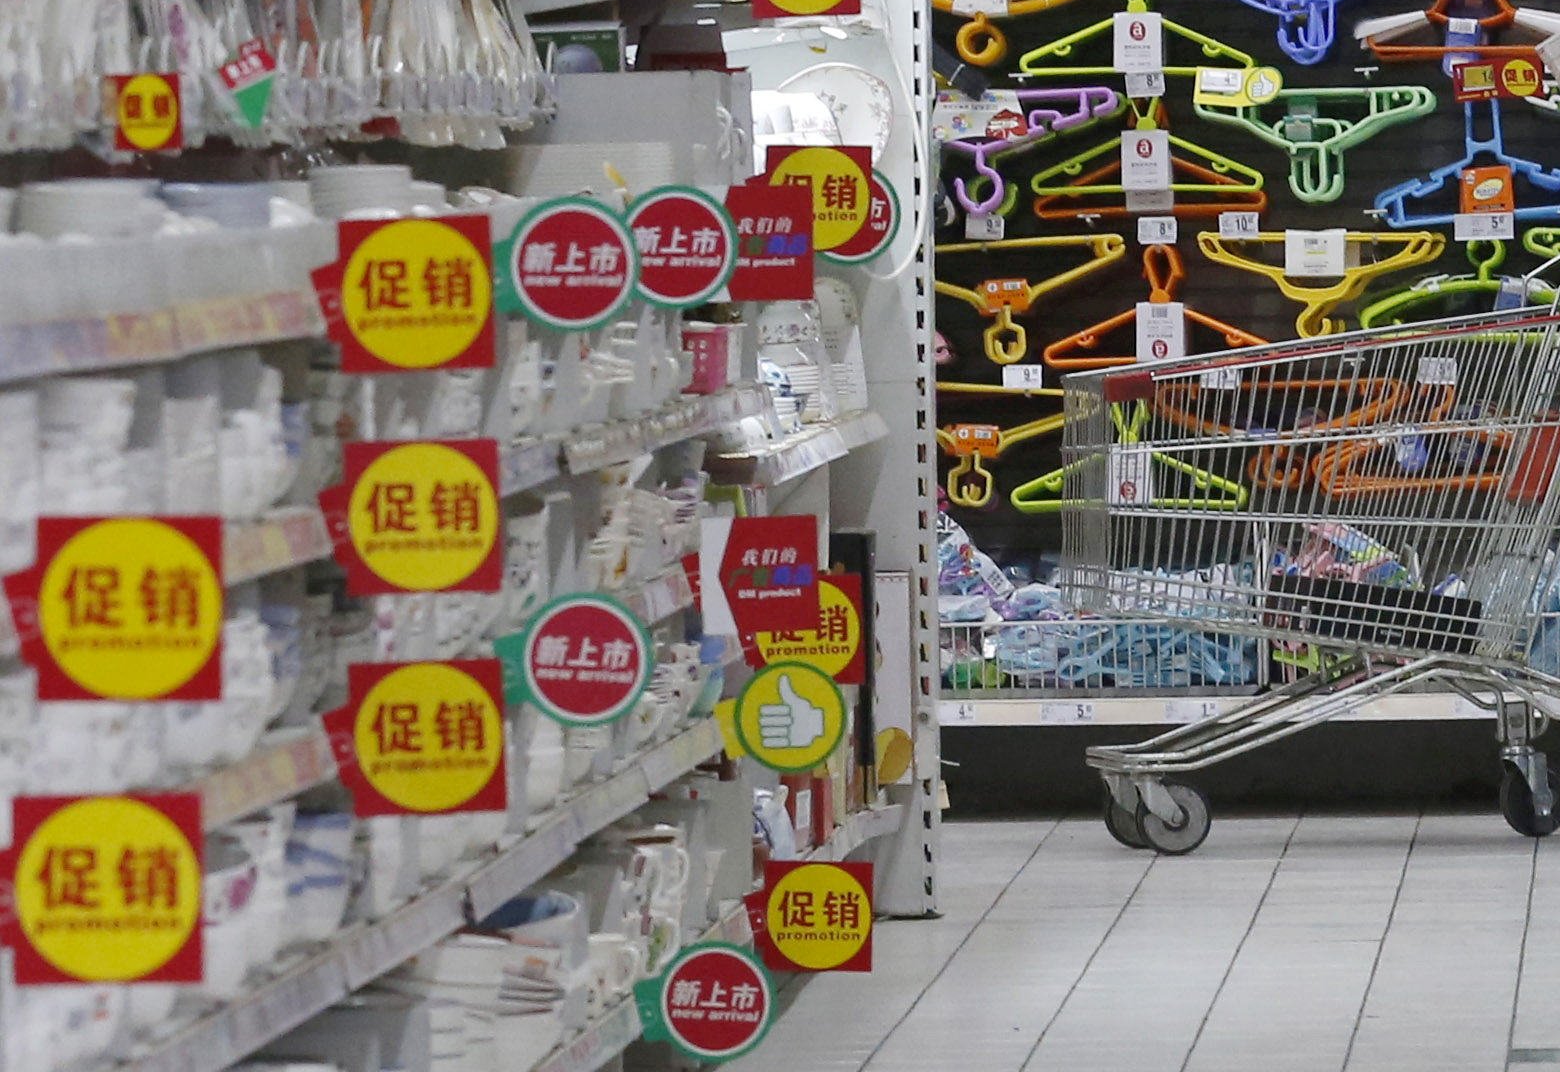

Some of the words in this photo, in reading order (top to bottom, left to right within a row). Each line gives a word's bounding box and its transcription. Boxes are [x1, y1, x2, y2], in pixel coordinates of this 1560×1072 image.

[358, 257, 476, 312] 促销
[366, 480, 483, 533] 促销
[62, 565, 202, 628] 促销
[766, 644, 850, 658] promotion
[371, 701, 487, 755] 促销
[36, 846, 180, 911] 促销
[778, 890, 860, 929] 促销
[776, 930, 861, 942] promotion
[671, 979, 760, 1012] 新上市
[671, 1008, 706, 1021] new
[708, 1008, 760, 1023] arrival
